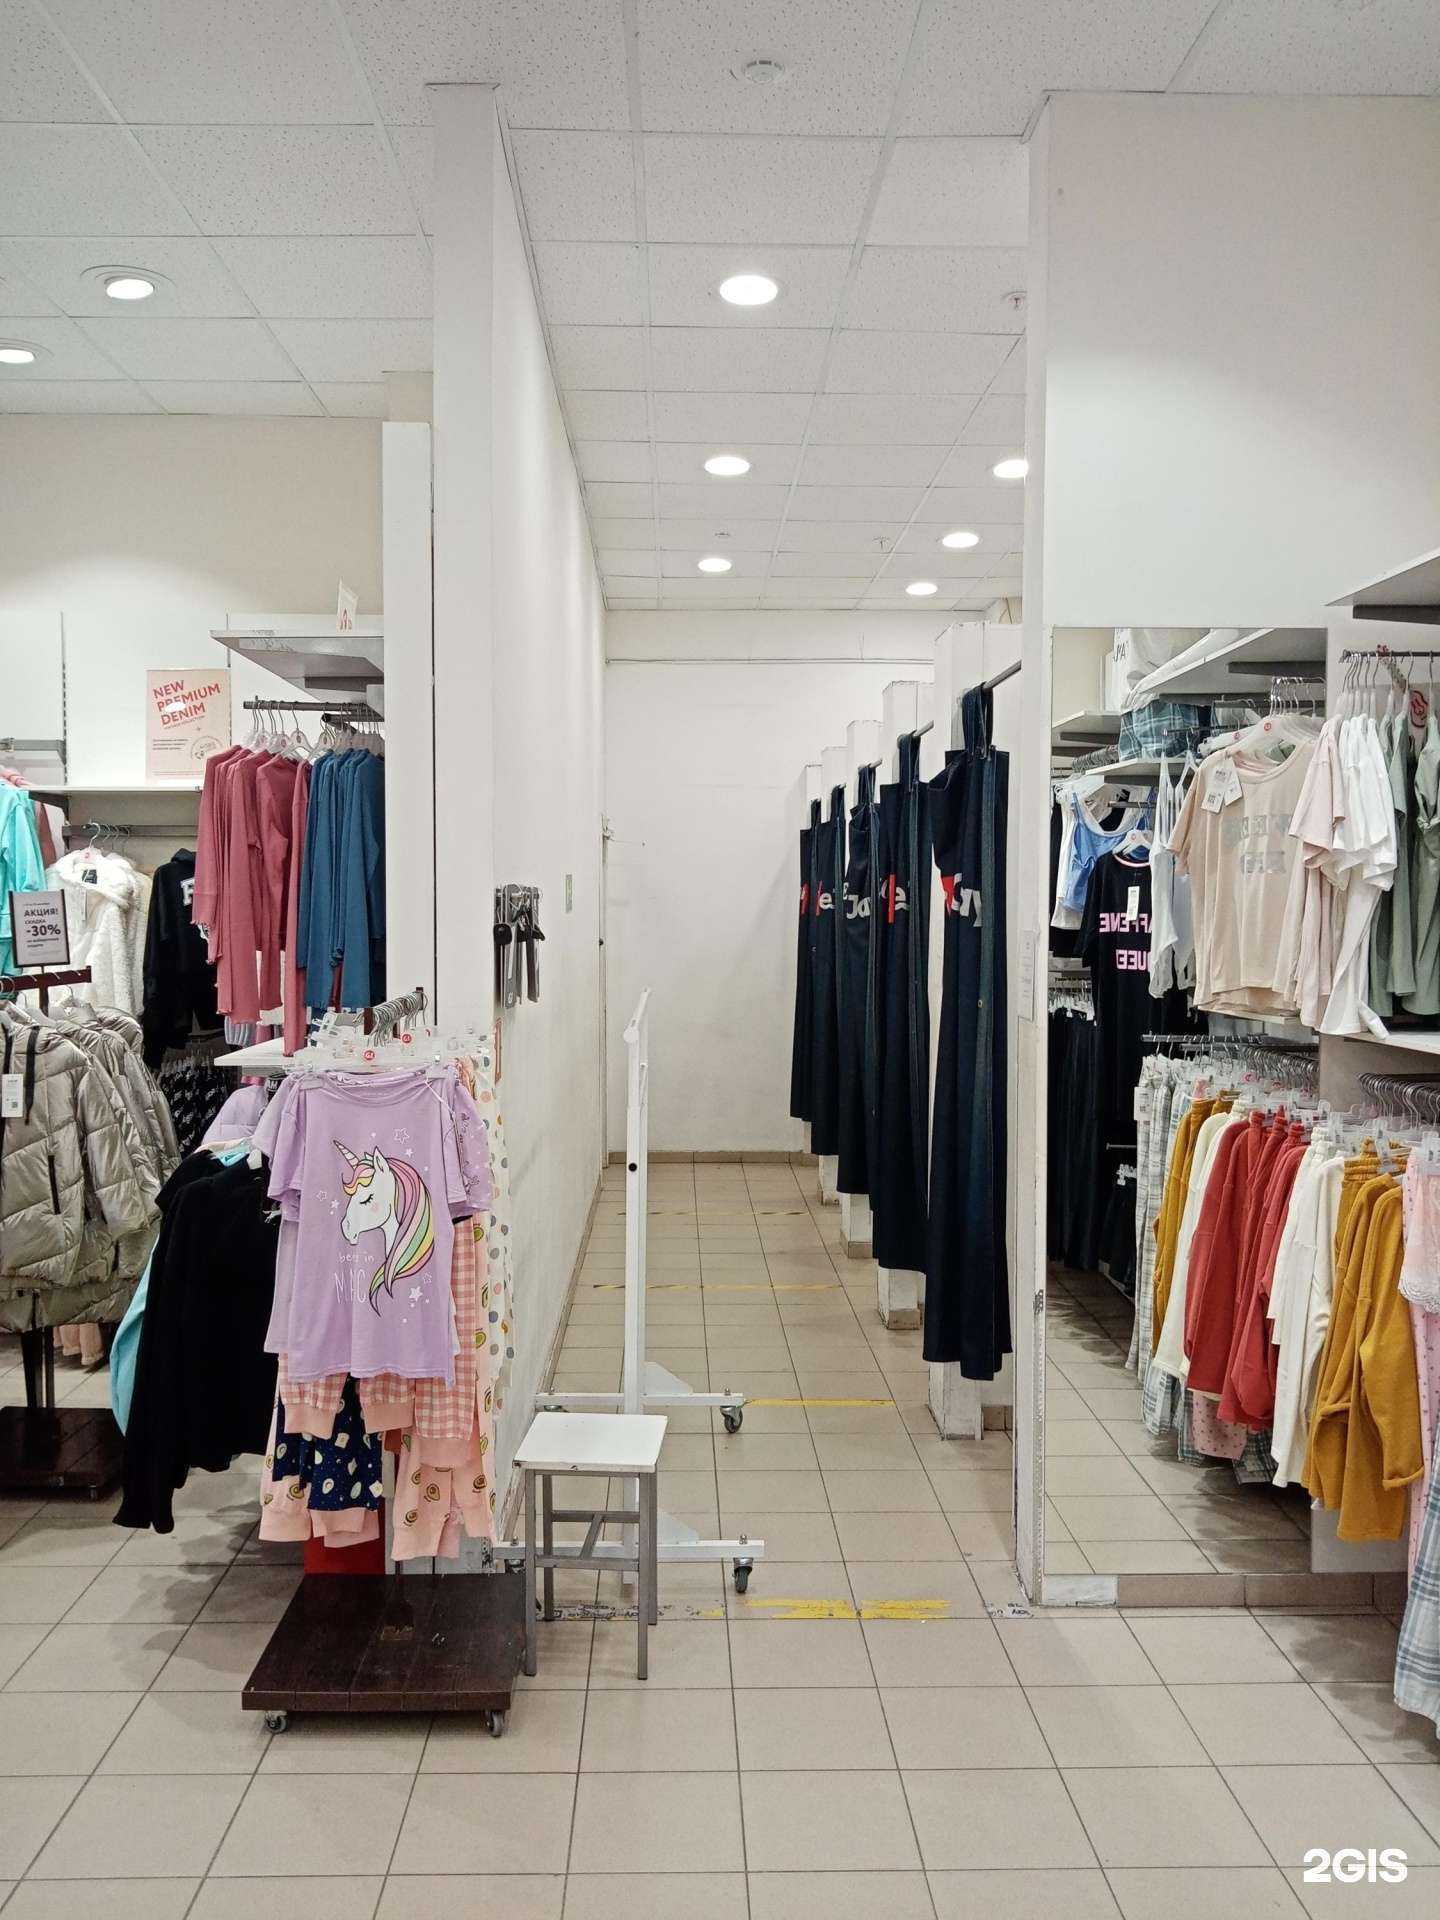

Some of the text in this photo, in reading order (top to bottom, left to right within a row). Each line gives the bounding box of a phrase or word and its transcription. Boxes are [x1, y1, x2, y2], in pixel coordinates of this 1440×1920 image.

[153, 680, 184, 699] NEW
[160, 702, 206, 725] DENIM
[24, 907, 58, 917] АКЦИЯ!
[26, 924, 61, 937] -30%
